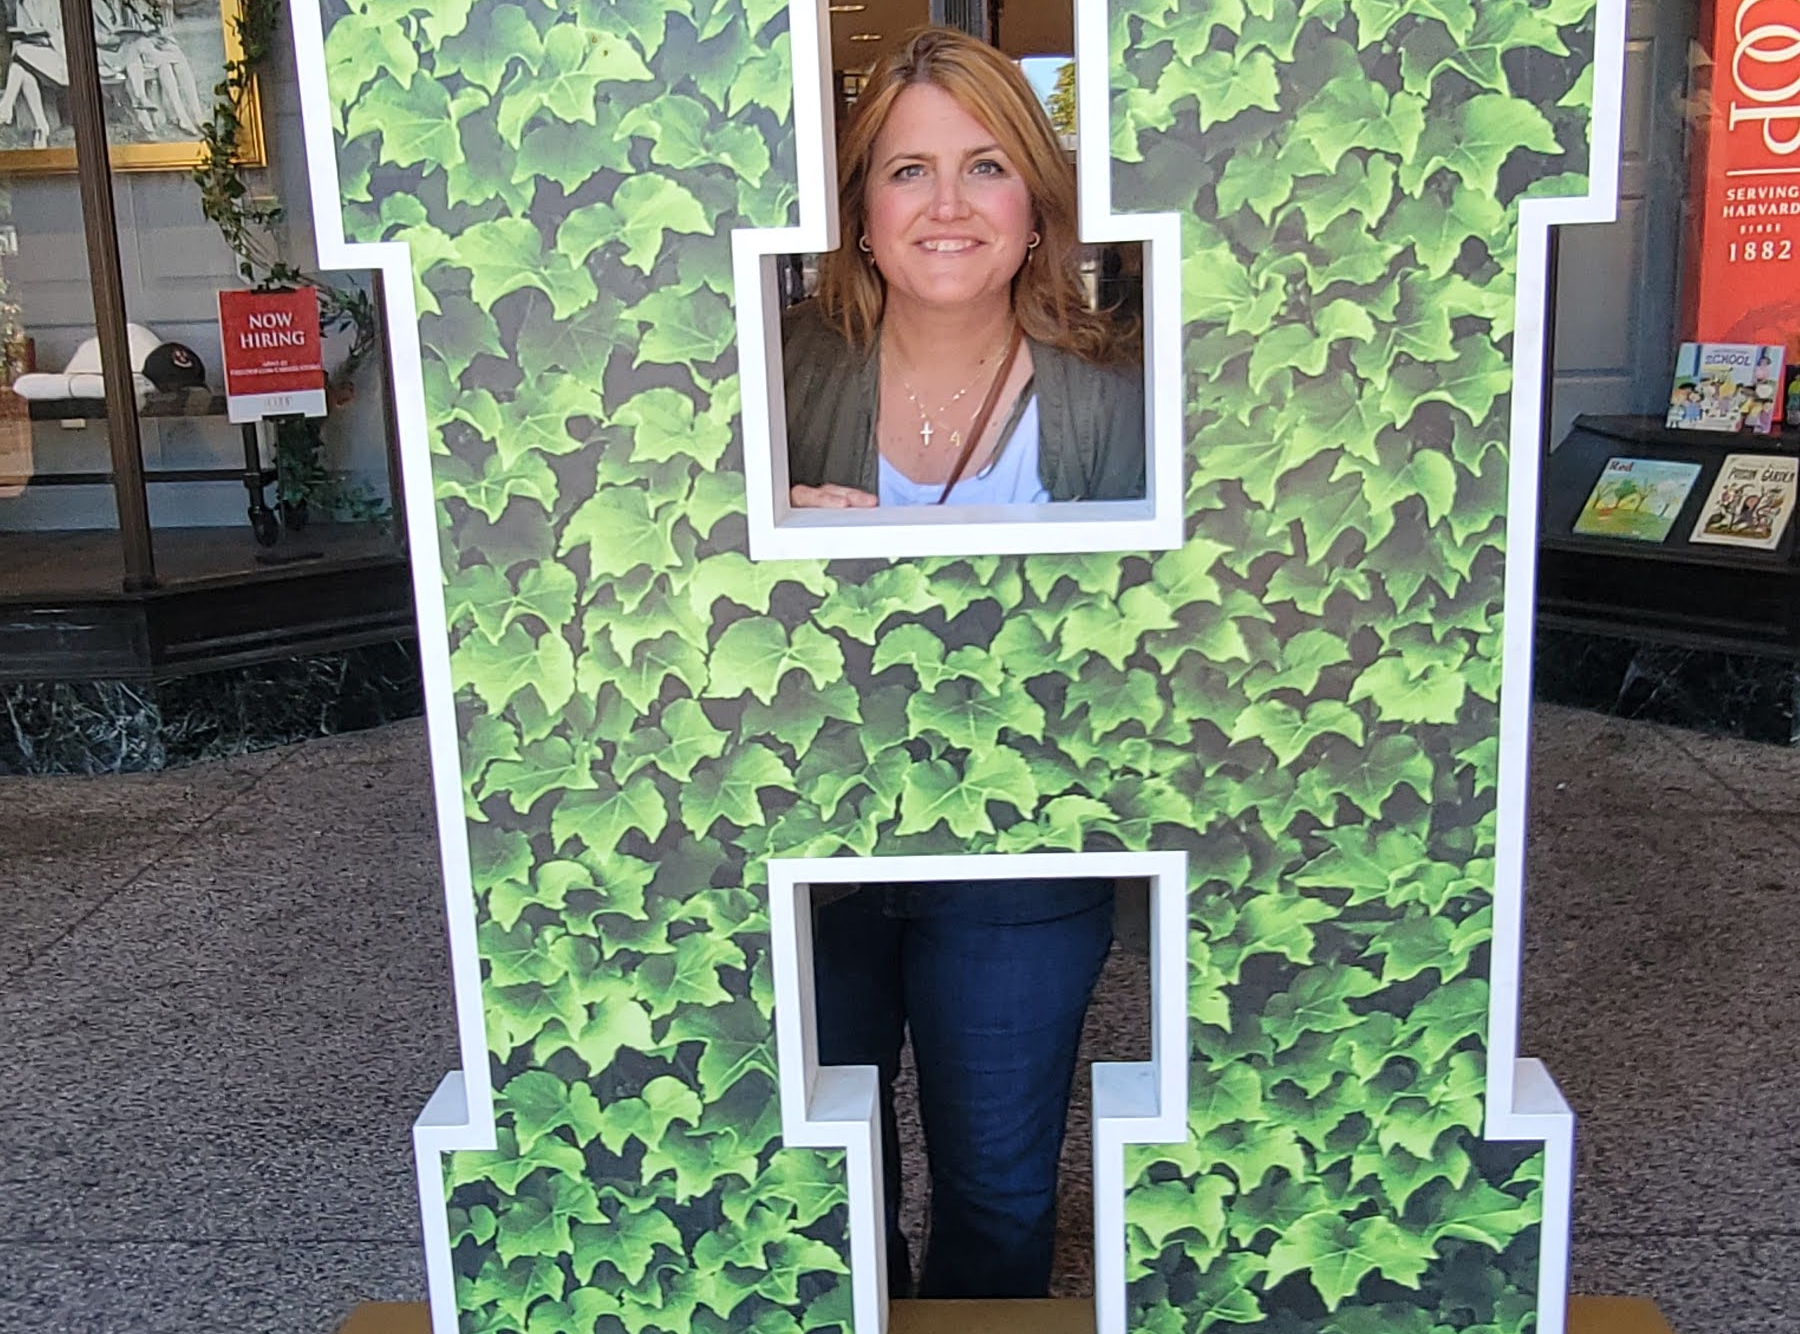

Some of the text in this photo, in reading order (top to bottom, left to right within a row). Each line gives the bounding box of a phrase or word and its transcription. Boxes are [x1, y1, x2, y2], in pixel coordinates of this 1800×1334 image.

[1726, 185, 1800, 201] SERVING
[1723, 202, 1800, 218] HARVARD
[1729, 240, 1792, 262] 1882
[249, 311, 293, 330] NOW
[240, 330, 305, 349] HIRING
[1705, 354, 1752, 366] SCHOOL
